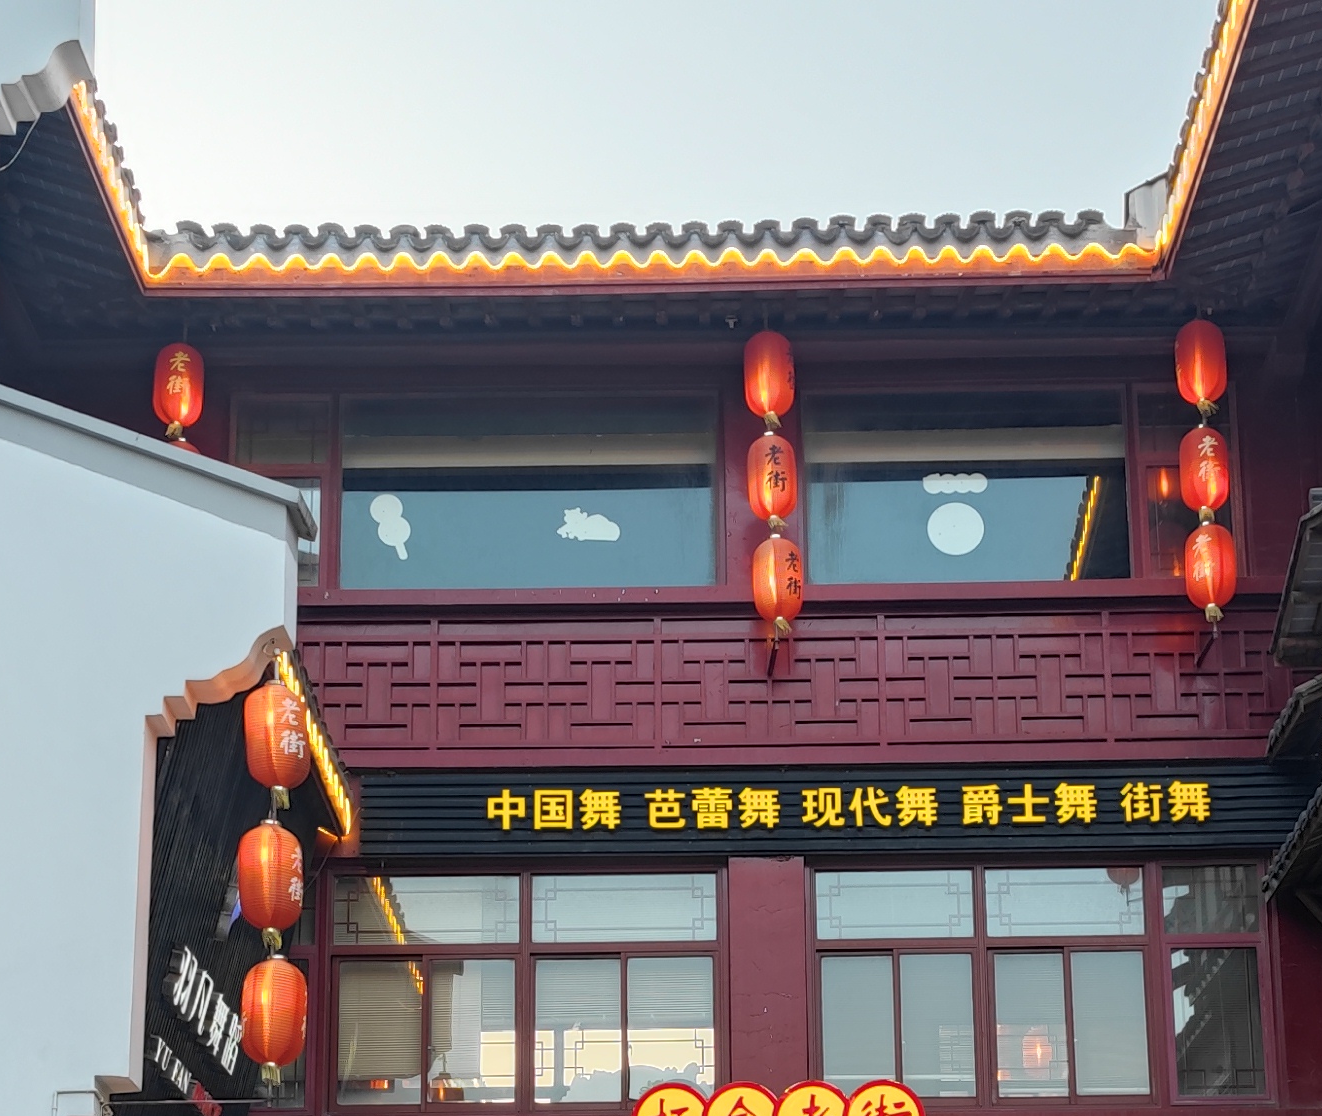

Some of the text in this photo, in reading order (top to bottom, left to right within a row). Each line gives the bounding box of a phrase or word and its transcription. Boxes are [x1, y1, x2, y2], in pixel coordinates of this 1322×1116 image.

[167, 351, 191, 397] 老街
[765, 444, 788, 493] 老街
[1197, 435, 1221, 483] 老街
[785, 551, 802, 600] 老街
[1192, 534, 1213, 582] 老街
[279, 697, 307, 760] 老街
[486, 780, 1211, 831] 中国舞 芭蕾舞 现代舞 爵士舞 街舞
[154, 1037, 173, 1071] YU
